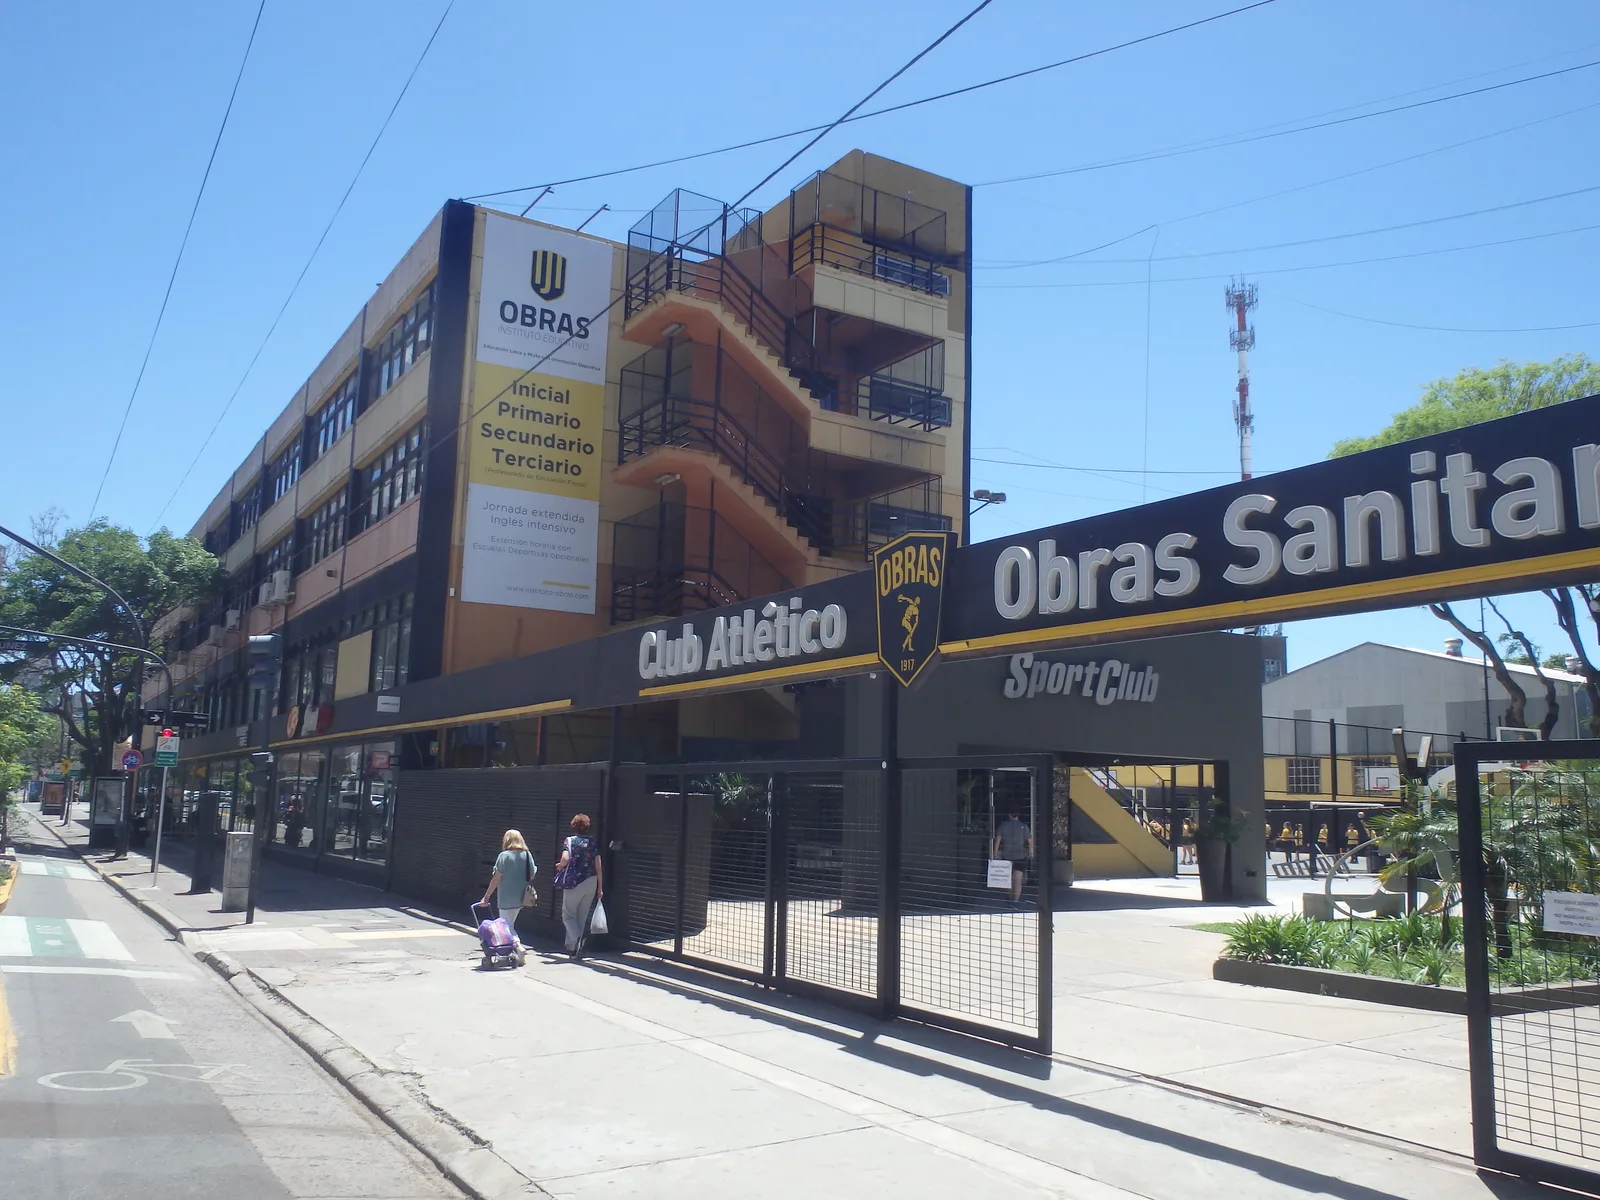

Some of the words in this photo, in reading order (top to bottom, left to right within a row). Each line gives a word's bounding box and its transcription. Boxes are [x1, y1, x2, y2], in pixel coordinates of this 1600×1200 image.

[500, 300, 590, 339] OBRAS
[498, 325, 541, 341] INSTITUTO
[512, 380, 570, 405] Inicial
[498, 401, 581, 430] Primario
[480, 422, 595, 455] Secundario
[492, 447, 582, 477] Terciario
[483, 501, 528, 515] Jornada
[531, 508, 585, 524] extendida
[490, 515, 523, 529] Inglés
[527, 519, 576, 535] intensivo
[472, 542, 506, 553] Escuelas
[508, 546, 549, 558] Deportivas
[550, 552, 589, 563] opcionales
[491, 536, 528, 547] Extensión
[530, 539, 556, 550] horaria
[558, 544, 572, 552] con
[879, 544, 941, 597] OBRAS
[994, 532, 1200, 620] Obras
[506, 585, 590, 600] www.instituto-obras.com
[639, 623, 703, 680] Club
[705, 596, 847, 671] Atlético
[900, 658, 915, 672] 1917
